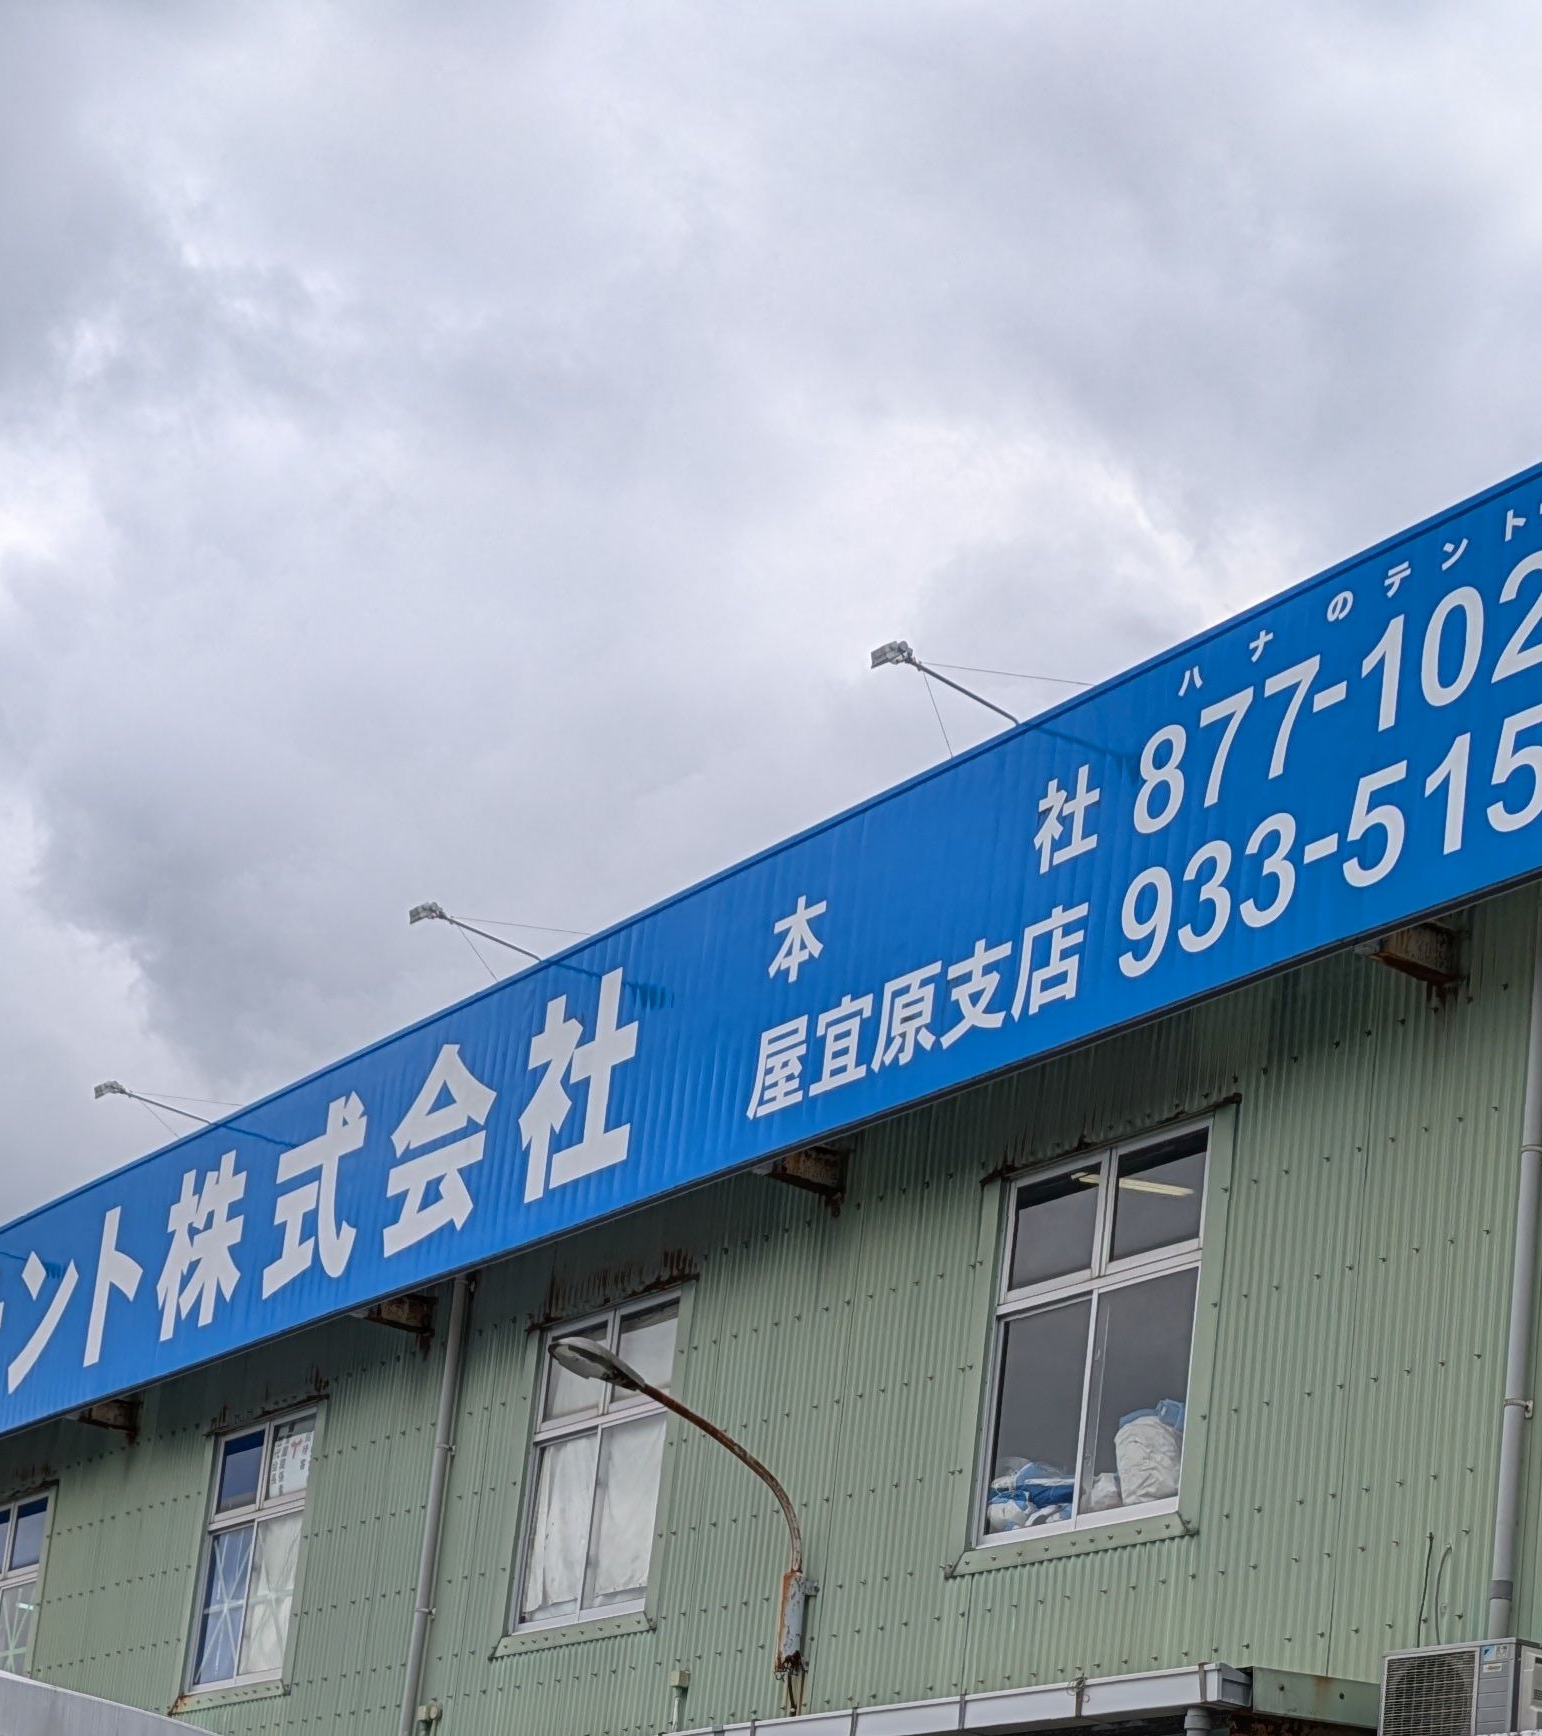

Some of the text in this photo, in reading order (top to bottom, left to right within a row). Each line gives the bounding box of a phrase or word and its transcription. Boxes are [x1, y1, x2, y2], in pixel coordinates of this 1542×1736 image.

[746, 902, 1089, 1120] 屋宜原支店
